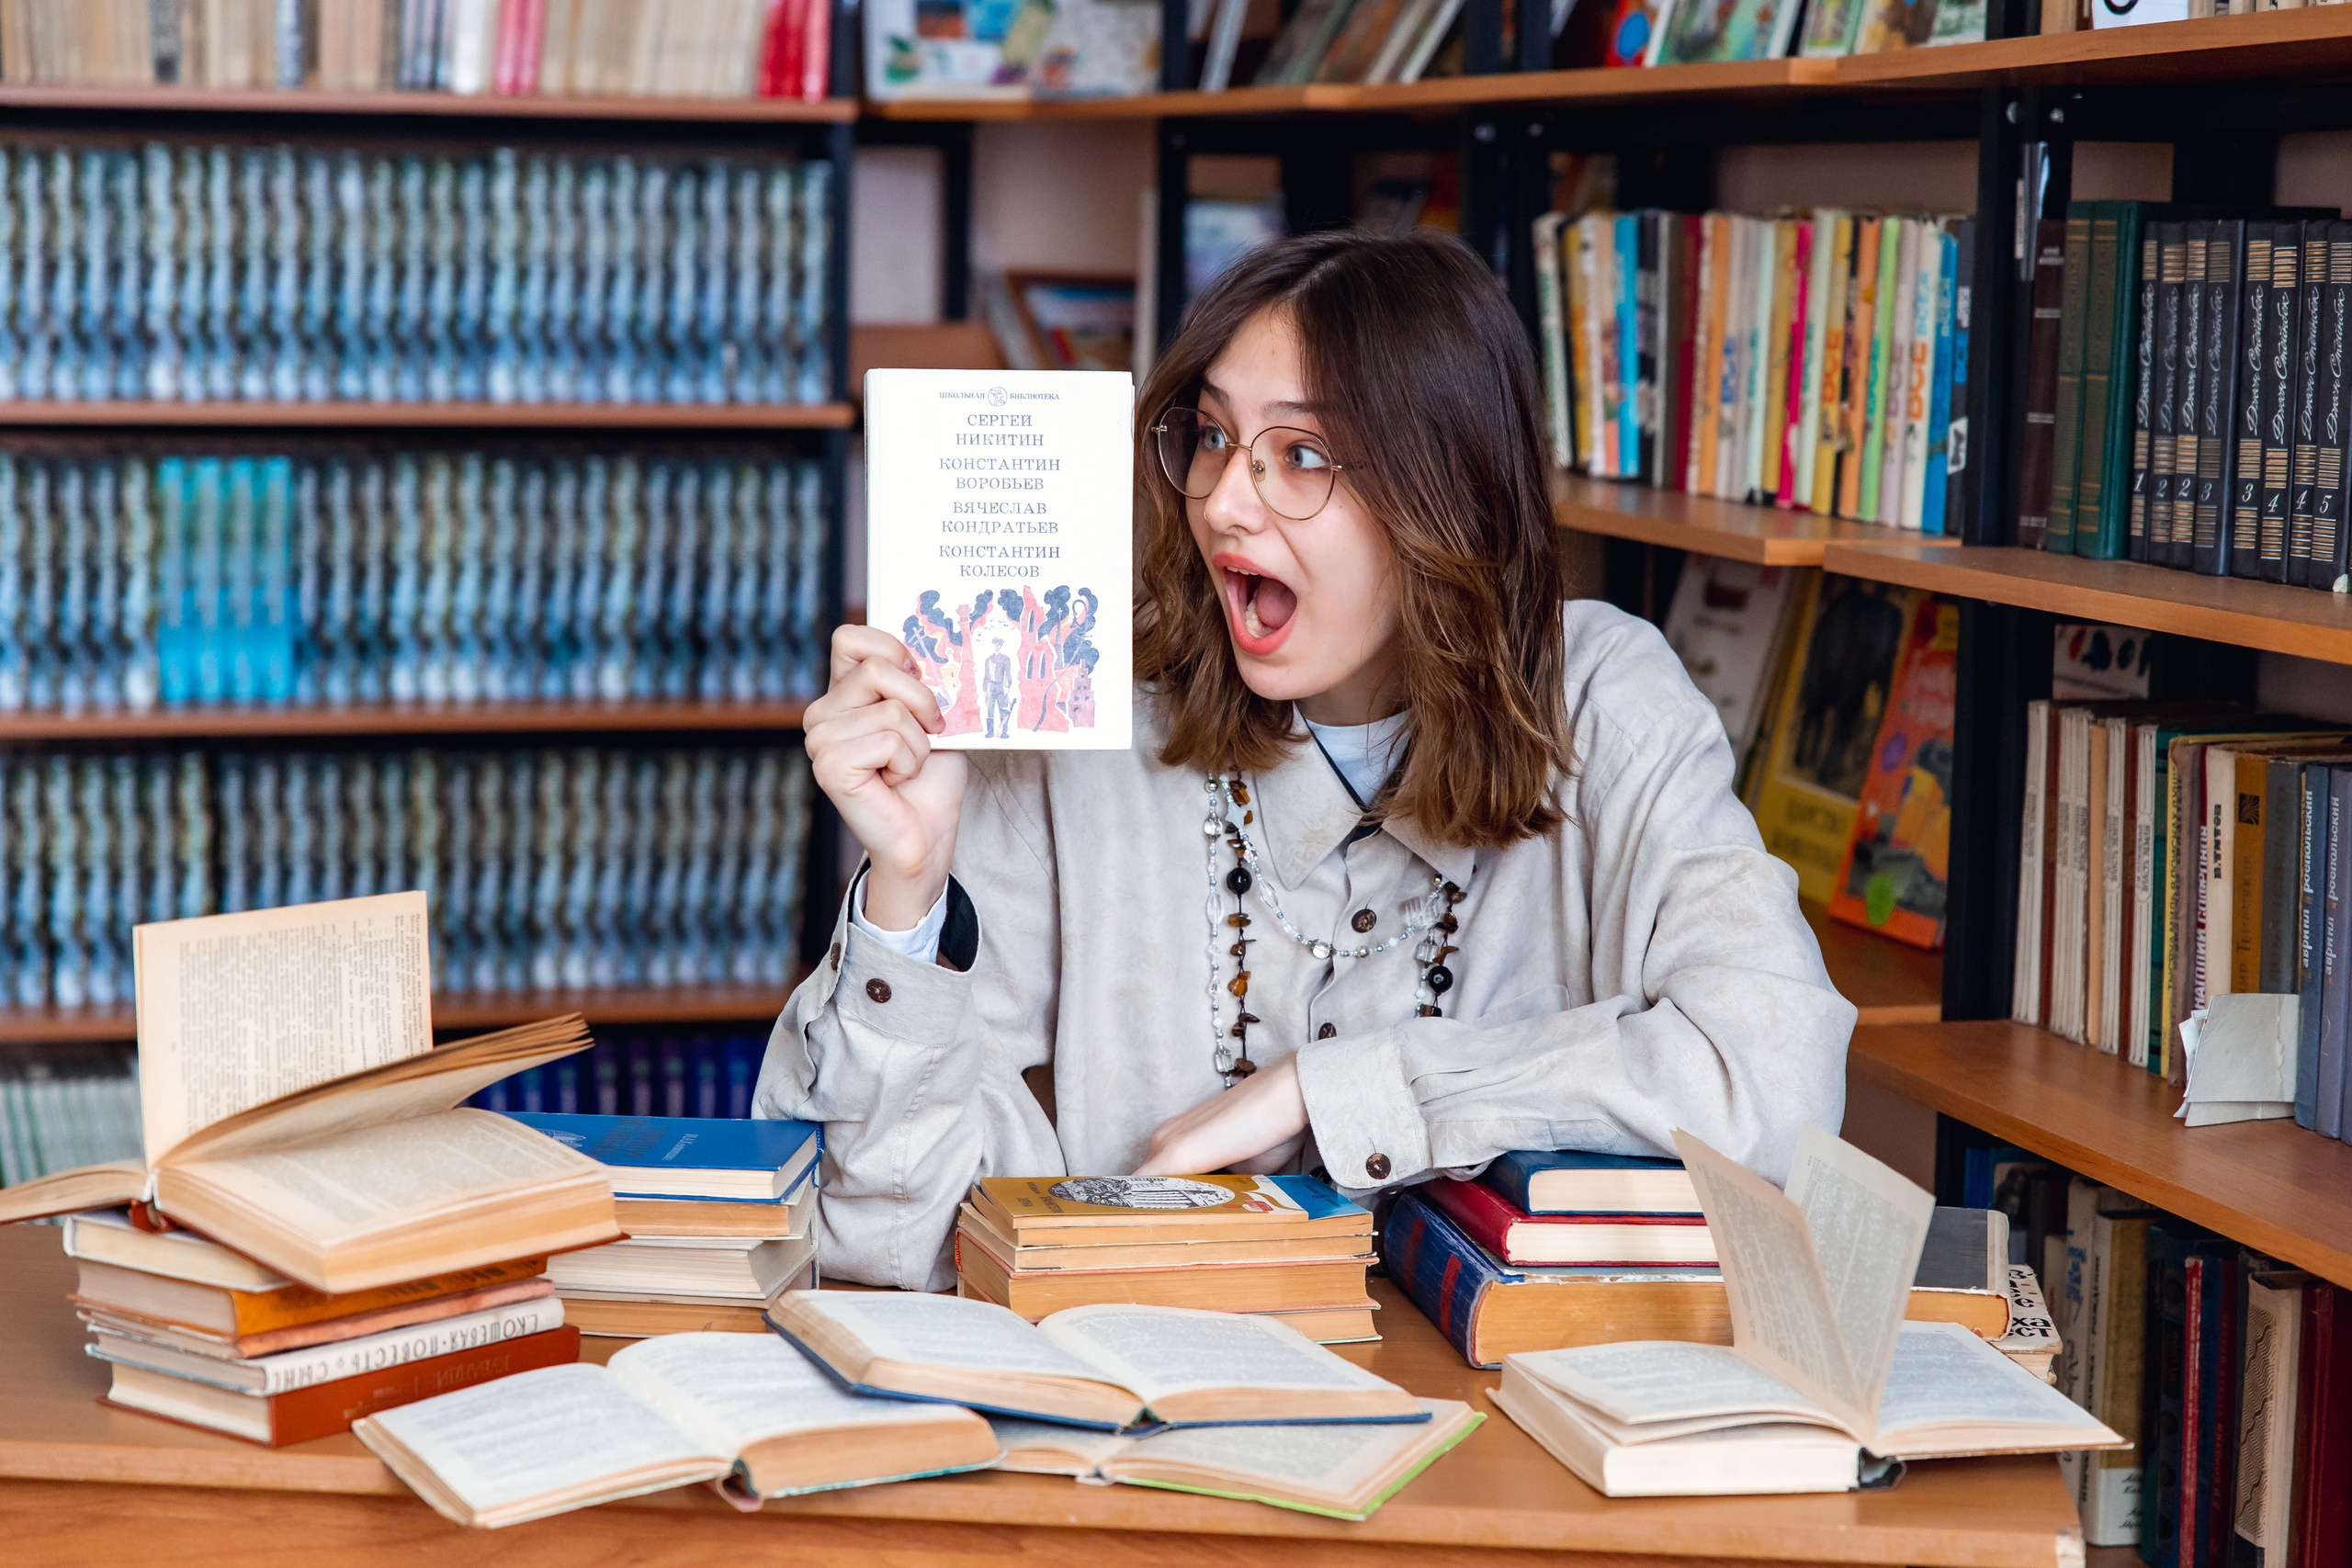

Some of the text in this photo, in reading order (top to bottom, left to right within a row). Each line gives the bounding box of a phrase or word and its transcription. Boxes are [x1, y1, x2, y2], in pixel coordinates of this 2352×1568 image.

[2136, 283, 2154, 427] Джон Стейнбек
[2160, 287, 2178, 432] Джон Стейнбек
[2183, 284, 2199, 432] Джон Стейнбек
[2205, 288, 2223, 435] Джон Стейнбек
[2246, 285, 2264, 435] Джон Стейнбек
[2301, 287, 2319, 440] Джон Стейнбек
[2272, 292, 2290, 445] Джон Стейнбек
[2325, 288, 2345, 445] Джон Стейнбек
[1907, 343, 1928, 420] ВСЕ
[967, 414, 1032, 426] СЕРГЕЙ
[956, 434, 1044, 446] НИКИТИН
[940, 458, 1060, 470] КОНСТАНТИН
[956, 478, 1044, 490] ВОРОБЬЕВ
[2134, 473, 2144, 492] 1
[2156, 479, 2167, 498] 2
[2178, 478, 2191, 497] 2
[2201, 482, 2212, 502] 3
[2243, 482, 2254, 502] 3
[953, 502, 1046, 514] ВЯЧЕСЛАВ
[2268, 493, 2280, 513] 4
[2297, 490, 2308, 509] 4
[2319, 494, 2333, 513] 5
[942, 521, 1058, 535] КОНДРАТЬЕВ
[939, 546, 1060, 558] КОНСТАНТИН
[960, 565, 1039, 577] КОЛЕСОВ
[2213, 805, 2222, 879] В.ТИТОВ
[2194, 825, 2208, 1010] НАТОЛИЙ СОФРОНОВ
[449, 1313, 539, 1352] Е.КОШЕВАЯ
[350, 1336, 438, 1374] ПОВЕСТЬ
